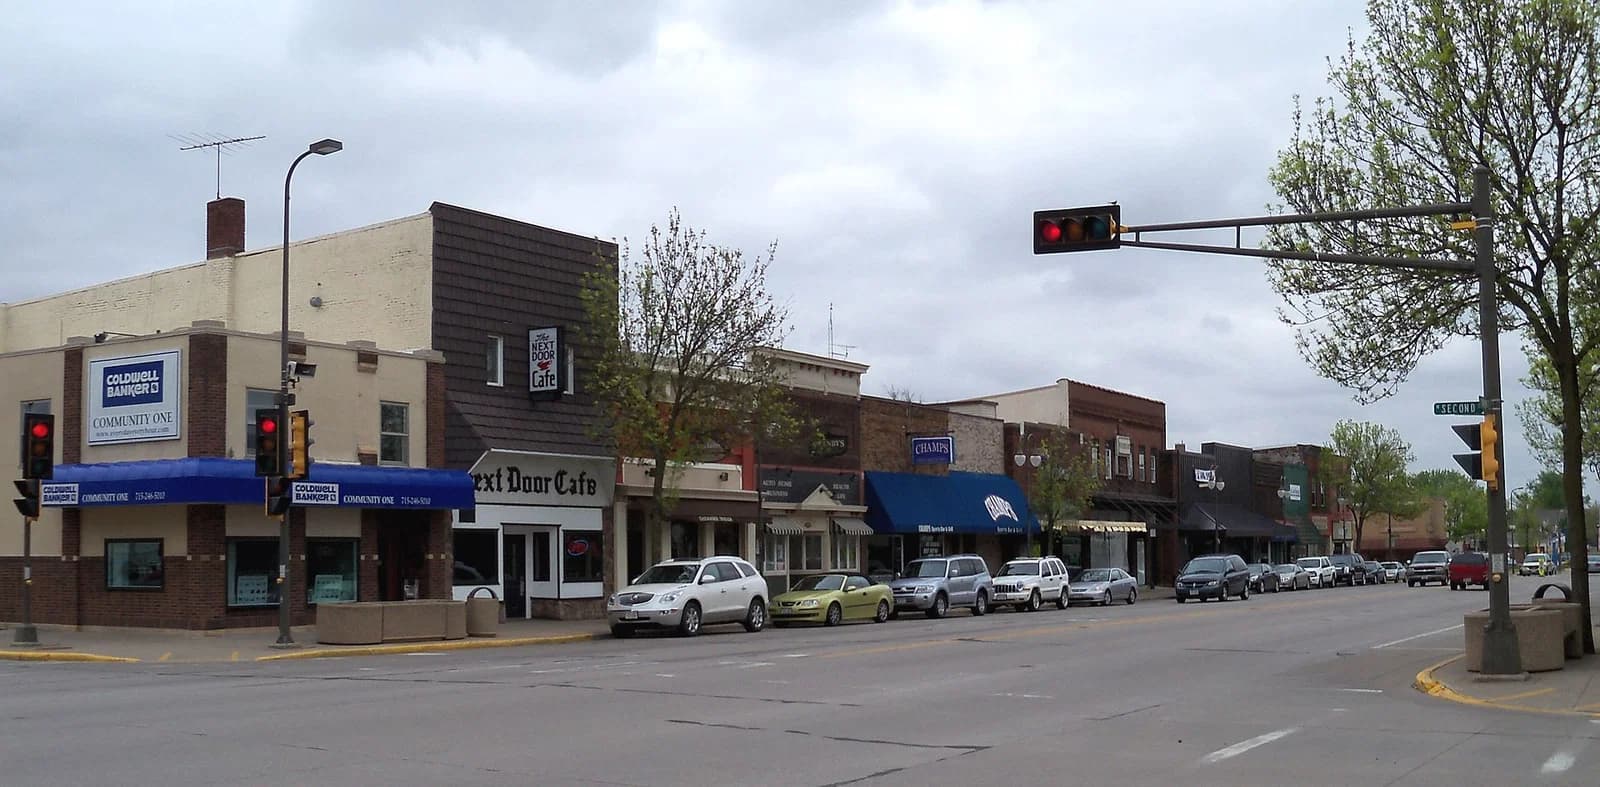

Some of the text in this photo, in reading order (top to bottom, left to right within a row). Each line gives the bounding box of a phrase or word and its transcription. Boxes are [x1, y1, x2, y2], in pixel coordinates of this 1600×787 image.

[531, 341, 554, 351] NEXT
[532, 350, 555, 361] DOOR
[106, 370, 160, 386] COLDWELL
[532, 370, 556, 388] Cafe
[107, 383, 150, 398] BANKER
[1441, 403, 1476, 413] SECOND
[93, 411, 173, 429] COMMUNITY ONE
[915, 441, 949, 455] CHAMPS
[473, 468, 503, 492] ext
[507, 466, 553, 494] Door
[296, 485, 337, 493] COLDWELL
[116, 493, 128, 501] ONE
[296, 492, 329, 502] BANKER
[343, 495, 381, 504] COMMUNITY
[381, 496, 394, 504] ONE
